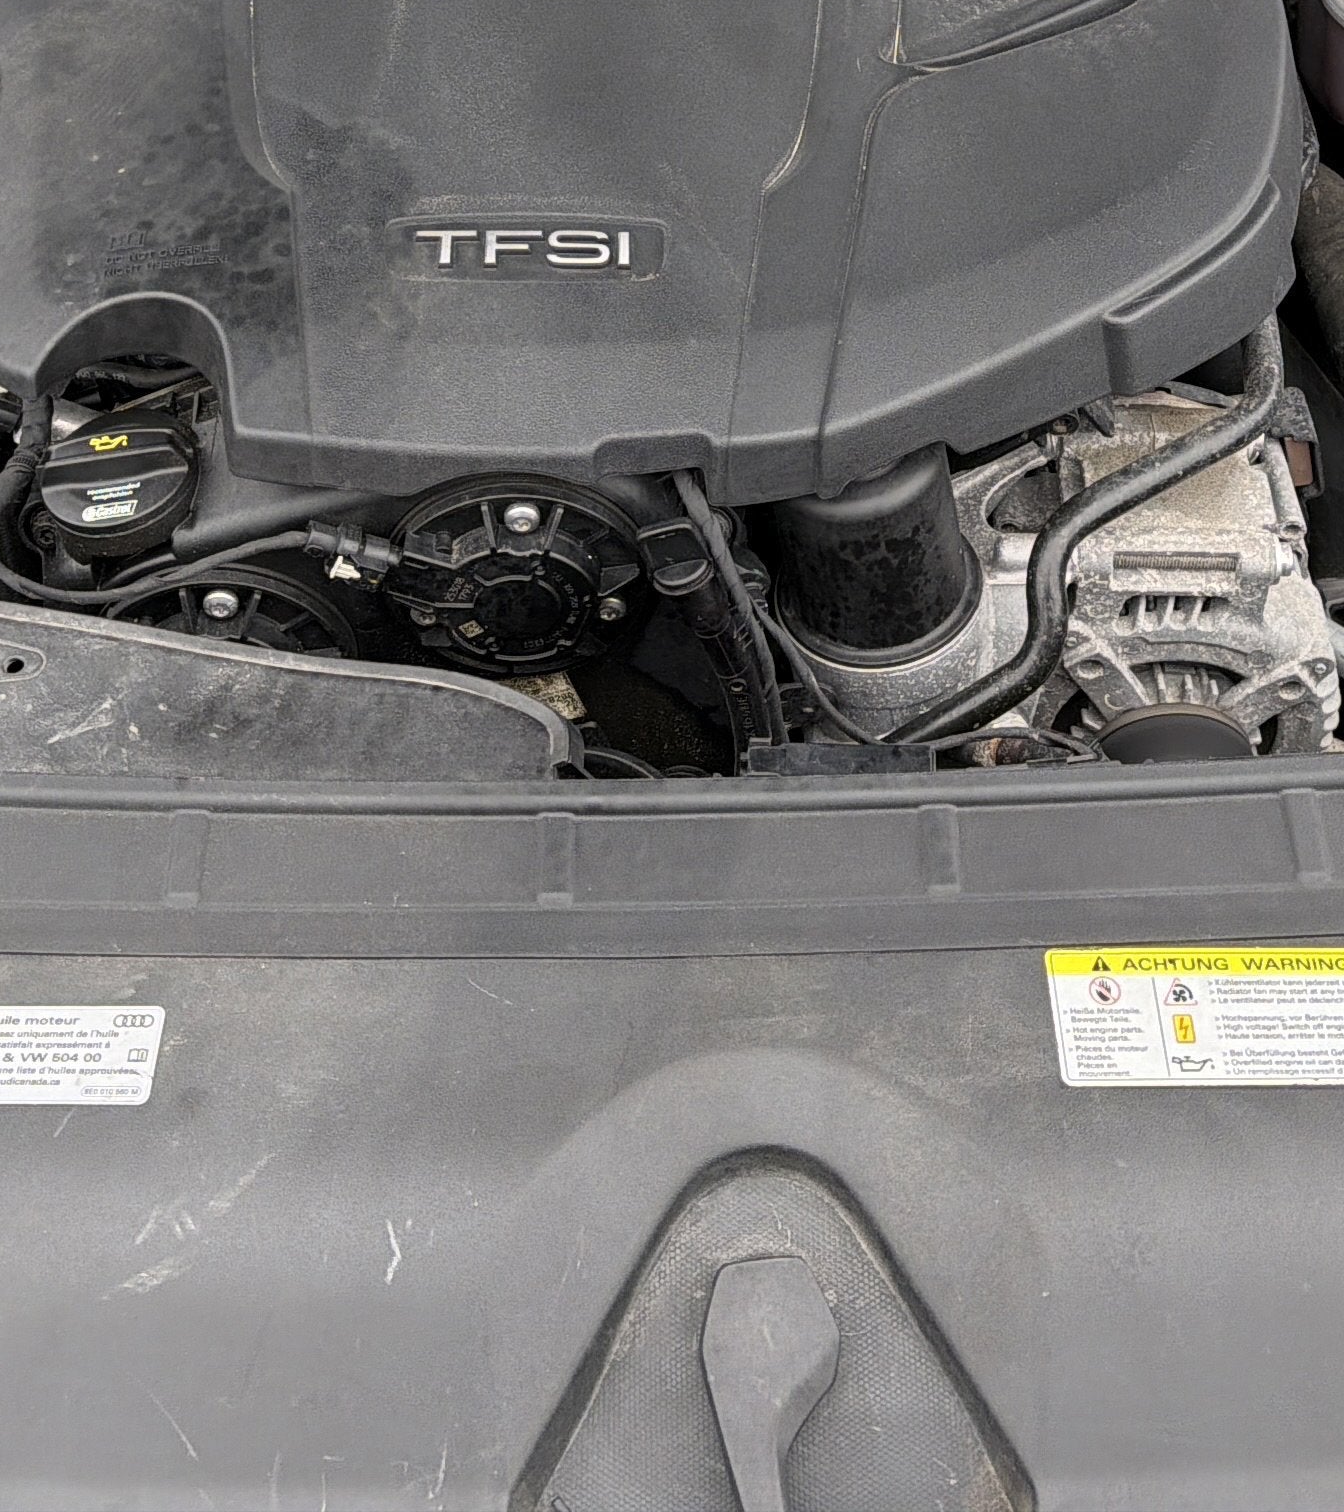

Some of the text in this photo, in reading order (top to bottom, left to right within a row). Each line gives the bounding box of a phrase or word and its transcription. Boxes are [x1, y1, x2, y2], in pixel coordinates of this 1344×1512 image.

[415, 229, 631, 267] TFSI
[1122, 957, 1229, 971] ACHTUNG
[1269, 989, 1288, 997] may
[1320, 989, 1336, 997] any
[1276, 997, 1296, 1005] peut
[25, 1015, 80, 1026] moteur
[1071, 1016, 1108, 1024] Bewegte
[1072, 1026, 1088, 1034] Hot
[1089, 1027, 1119, 1035] engine
[1222, 1023, 1244, 1032] High
[1281, 1023, 1311, 1031] Switch
[17, 1029, 74, 1039] uniquement
[76, 1029, 89, 1038] de
[1224, 1032, 1251, 1040] Haute
[1073, 1035, 1106, 1043] Moving
[1074, 1045, 1103, 1053] Pièces
[1229, 1049, 1244, 1057] Bei
[1297, 1049, 1329, 1057] besteht
[2, 1053, 15, 1062] &
[21, 1053, 49, 1062] VW
[51, 1053, 79, 1063] 504
[83, 1053, 102, 1063] 00
[1274, 1059, 1304, 1067] engine
[16, 1066, 36, 1074] liste
[1247, 1068, 1299, 1076] remplissage
